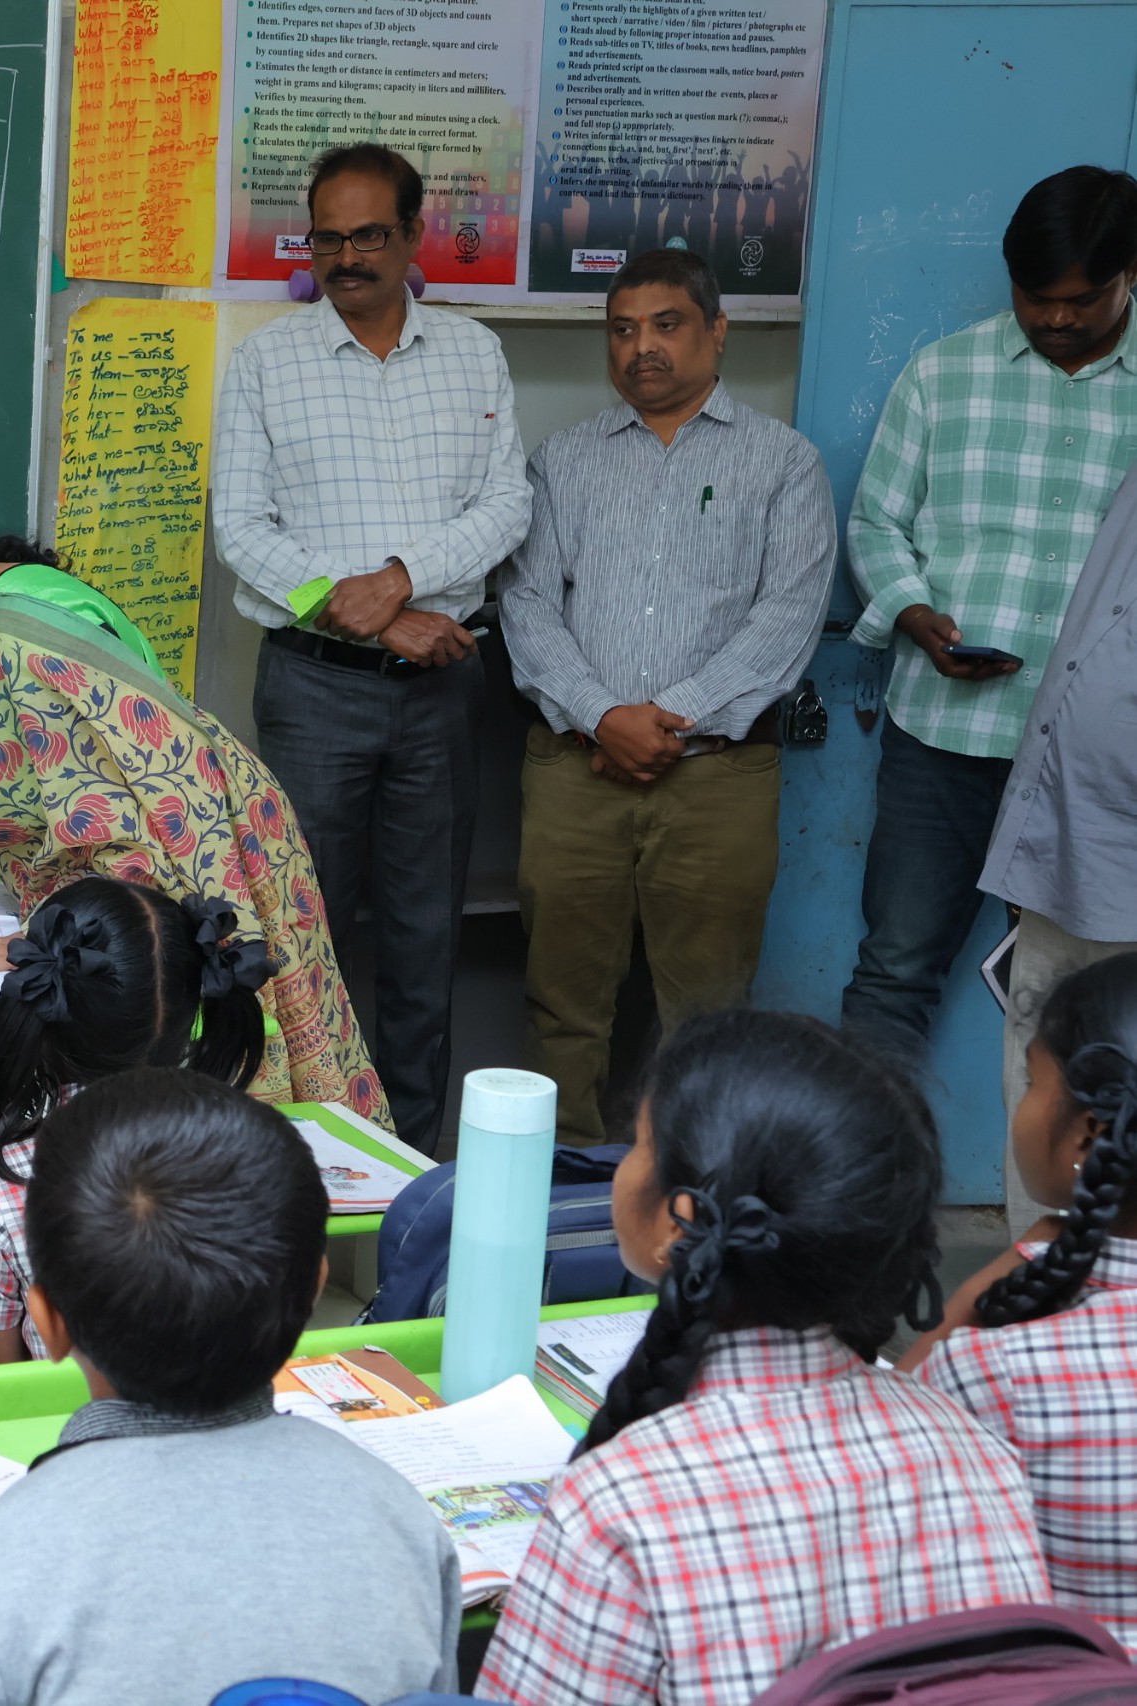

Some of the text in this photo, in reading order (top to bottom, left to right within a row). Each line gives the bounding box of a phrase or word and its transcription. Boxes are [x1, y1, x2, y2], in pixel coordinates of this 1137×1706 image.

[257, 0, 491, 19] Identifies edges, corners and faces of 3D objects and counts
[256, 16, 415, 34] them. Prepares net shapes of 3D objects
[570, 25, 593, 34] Reads
[595, 26, 616, 35] aloud
[617, 27, 627, 37] by
[629, 28, 663, 39] following
[664, 32, 691, 40] proper
[692, 30, 730, 40] intonation
[731, 32, 746, 41] and
[256, 31, 498, 50] Identifies 2D shapes like triangle, rectangle, square and circle
[569, 36, 592, 45] Reads
[594, 37, 628, 46] sub-titles
[656, 40, 674, 48] titles
[675, 40, 684, 49] of
[770, 44, 806, 56] pamphlets
[255, 46, 377, 60] by counting sides and corners.
[255, 61, 294, 72] Estimates
[296, 63, 309, 72] the
[311, 64, 337, 76] length
[349, 65, 382, 76] distance
[384, 67, 392, 76] in
[394, 67, 440, 78] centimeters
[441, 69, 456, 79] and
[458, 70, 488, 81] meters;
[568, 60, 591, 69] Reads
[592, 61, 620, 72] printed
[622, 62, 643, 73] script
[656, 64, 668, 72] the
[669, 64, 707, 74] classroom
[731, 67, 754, 75] notice
[780, 68, 804, 79] posters
[254, 76, 506, 95] weight in grams and kilograms; capacity in liters and milliliters.
[71, 328, 113, 343] To me
[70, 351, 112, 365] To us
[68, 362, 121, 381] To them
[66, 384, 115, 402] To him
[66, 403, 113, 423] To her
[64, 421, 110, 447] To that
[63, 448, 123, 465] Give me
[66, 485, 98, 499] Taste
[57, 503, 92, 520] Show
[93, 546, 114, 556] one
